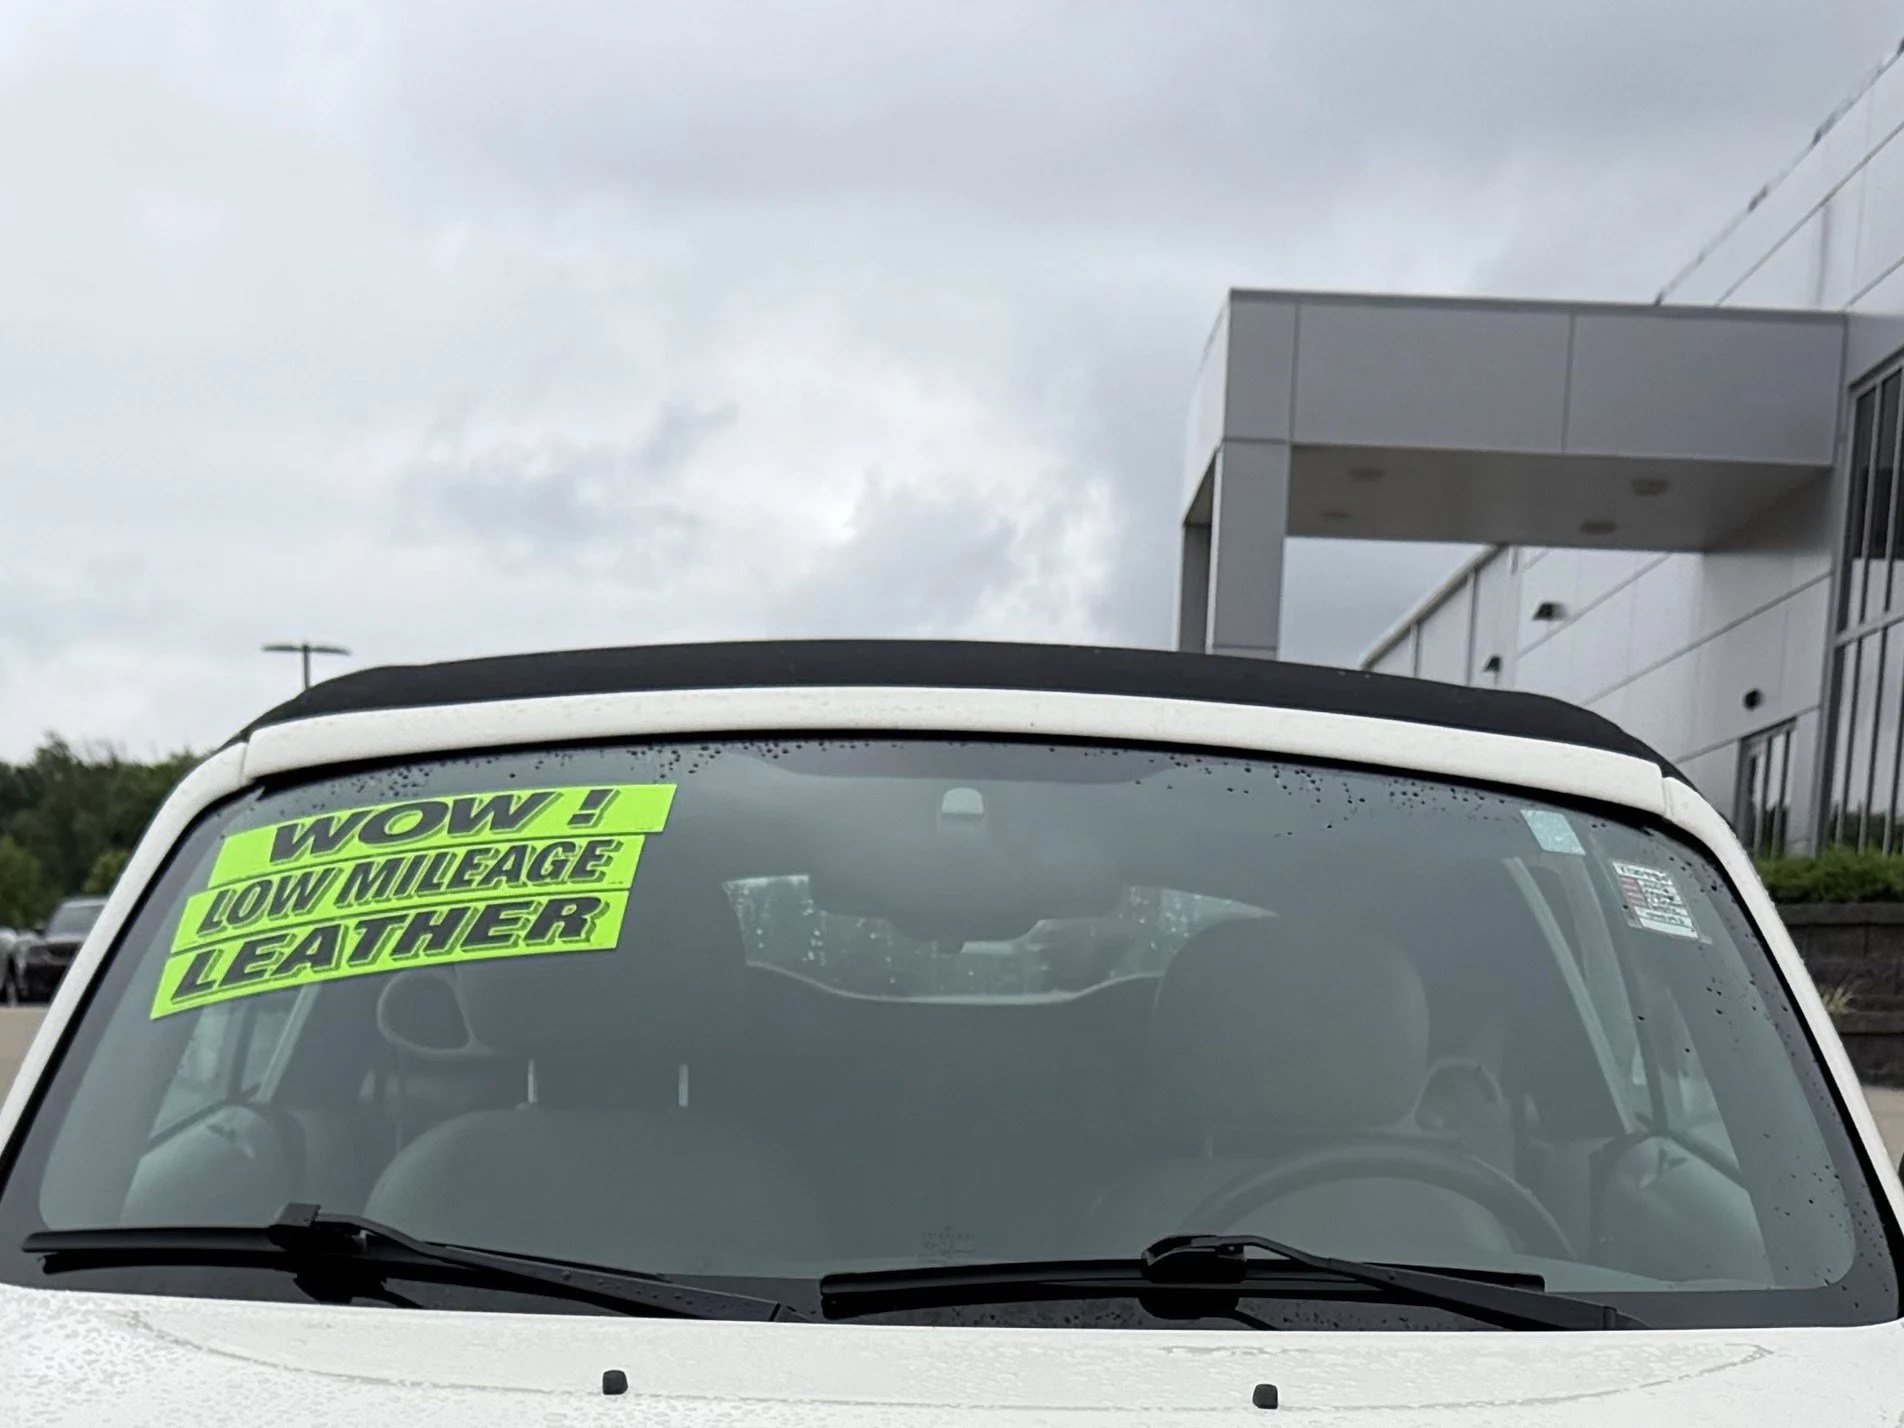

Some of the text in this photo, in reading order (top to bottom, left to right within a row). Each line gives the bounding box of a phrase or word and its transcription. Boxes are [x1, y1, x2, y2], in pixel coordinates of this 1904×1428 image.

[197, 838, 625, 938] LOW MILEAGE
[171, 896, 611, 1006] LEATHER
